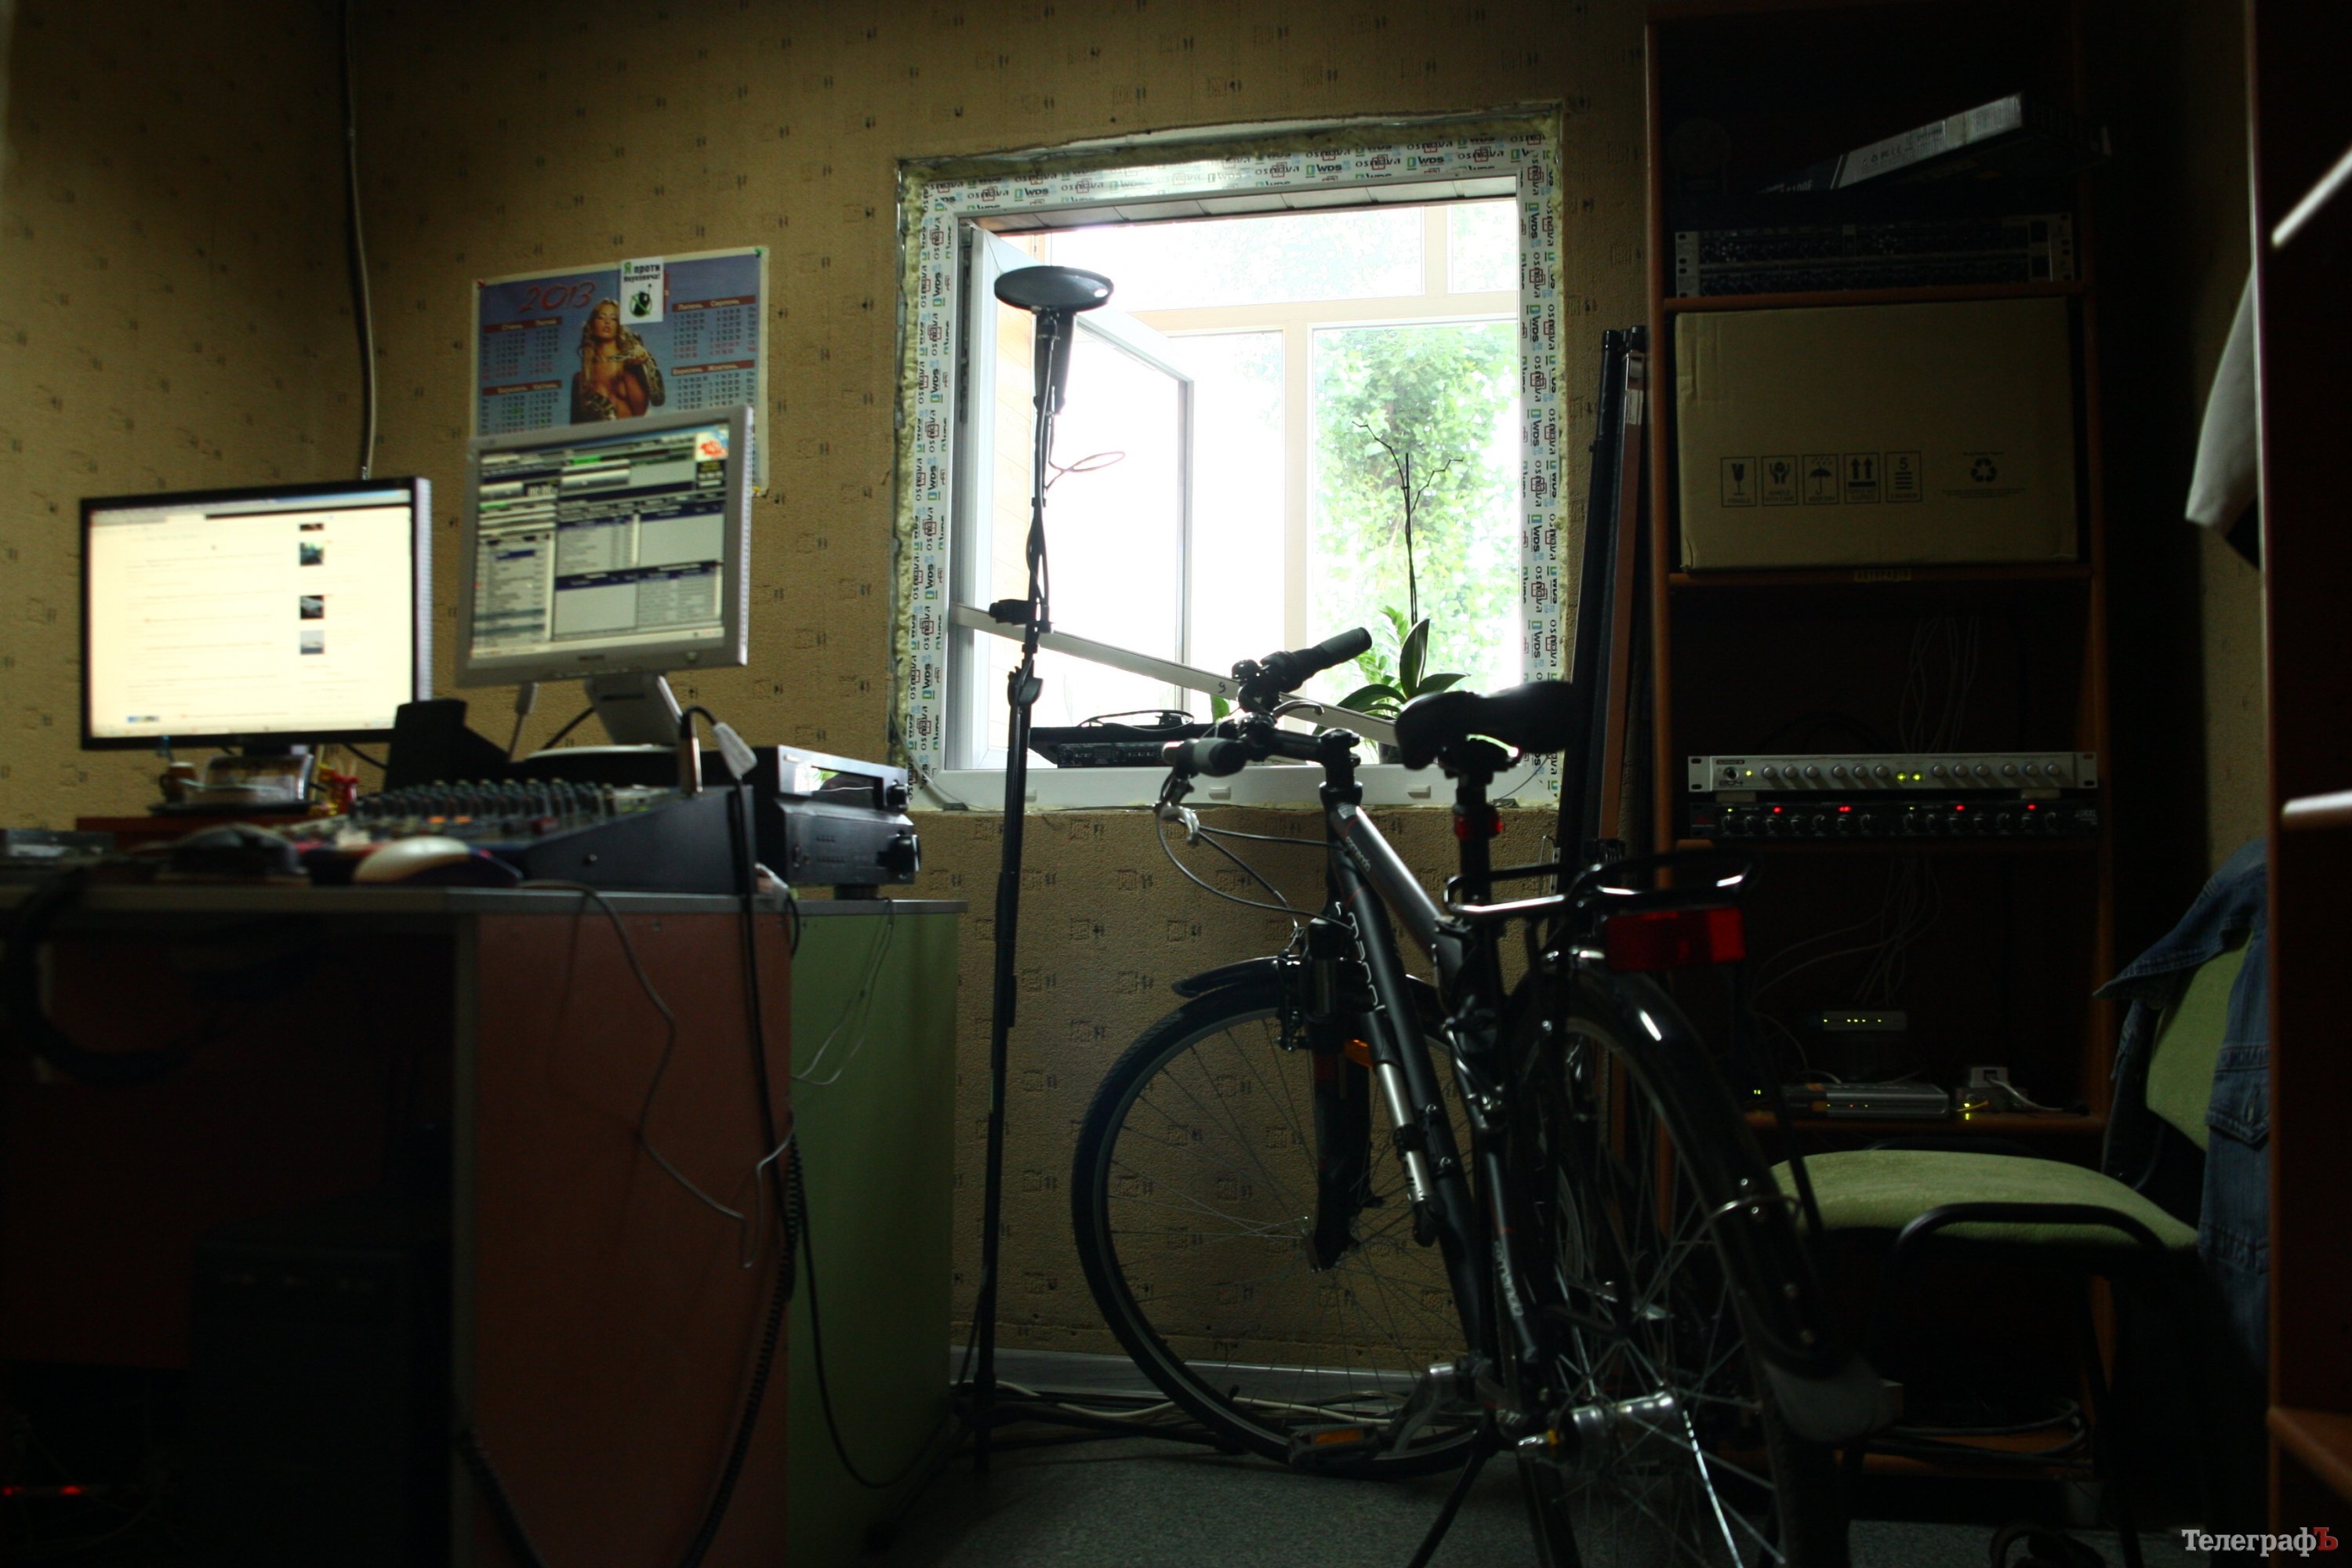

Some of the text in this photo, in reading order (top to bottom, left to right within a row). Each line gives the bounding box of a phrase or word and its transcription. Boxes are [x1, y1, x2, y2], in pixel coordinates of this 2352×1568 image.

[1418, 156, 1444, 165] WDS
[1024, 188, 1049, 197] WDS
[1531, 212, 1540, 238] WDS
[633, 264, 660, 274] проти
[518, 280, 597, 313] 2013
[1532, 315, 1541, 343] WDS
[1533, 419, 1542, 447] WDS
[1898, 457, 1908, 470] 5
[1534, 524, 1542, 552] WDS
[925, 564, 934, 589] WDS
[1534, 631, 1543, 658] WDS
[922, 663, 931, 688] WDS
